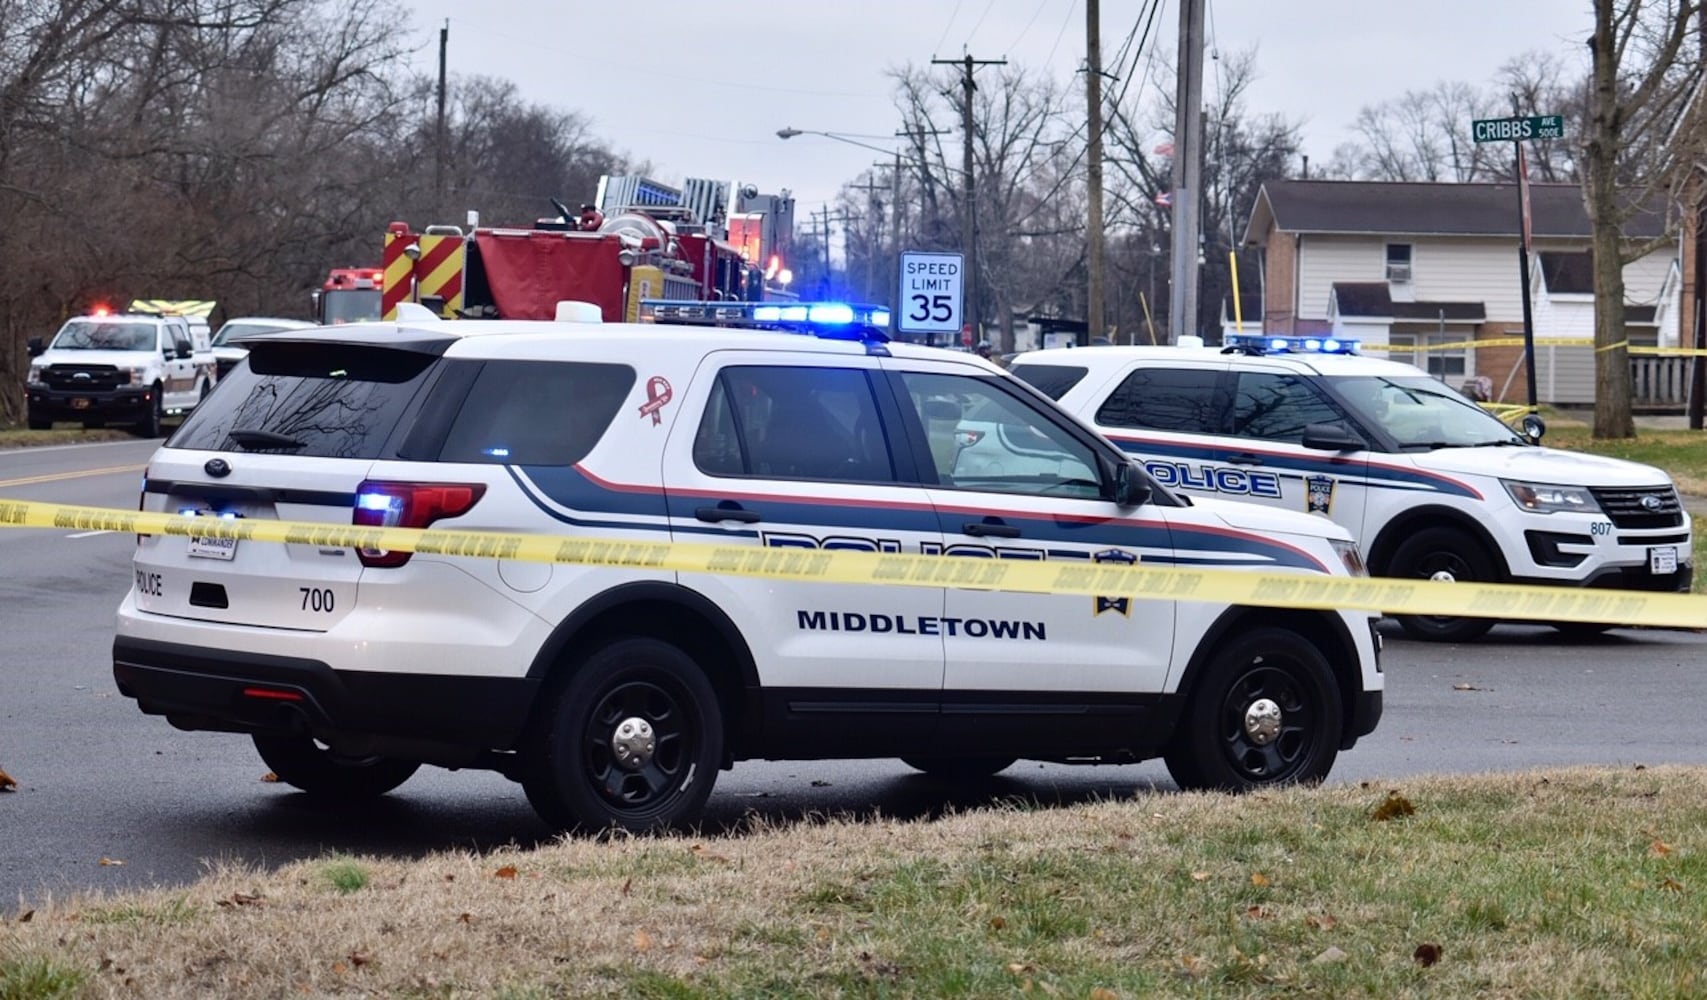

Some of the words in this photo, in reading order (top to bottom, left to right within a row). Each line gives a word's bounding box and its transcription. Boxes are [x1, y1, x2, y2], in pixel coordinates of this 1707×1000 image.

[1476, 120, 1532, 139] CRIBBS
[1541, 117, 1556, 127] AVE
[1538, 127, 1560, 138] 500E
[907, 262, 958, 275] SPEED
[912, 278, 951, 291] LIMIT
[910, 294, 953, 322] 35
[1135, 458, 1282, 498] OLICE
[1590, 522, 1612, 535] 807
[300, 587, 335, 613] 700
[797, 610, 1047, 640] MIDDLETOWN
